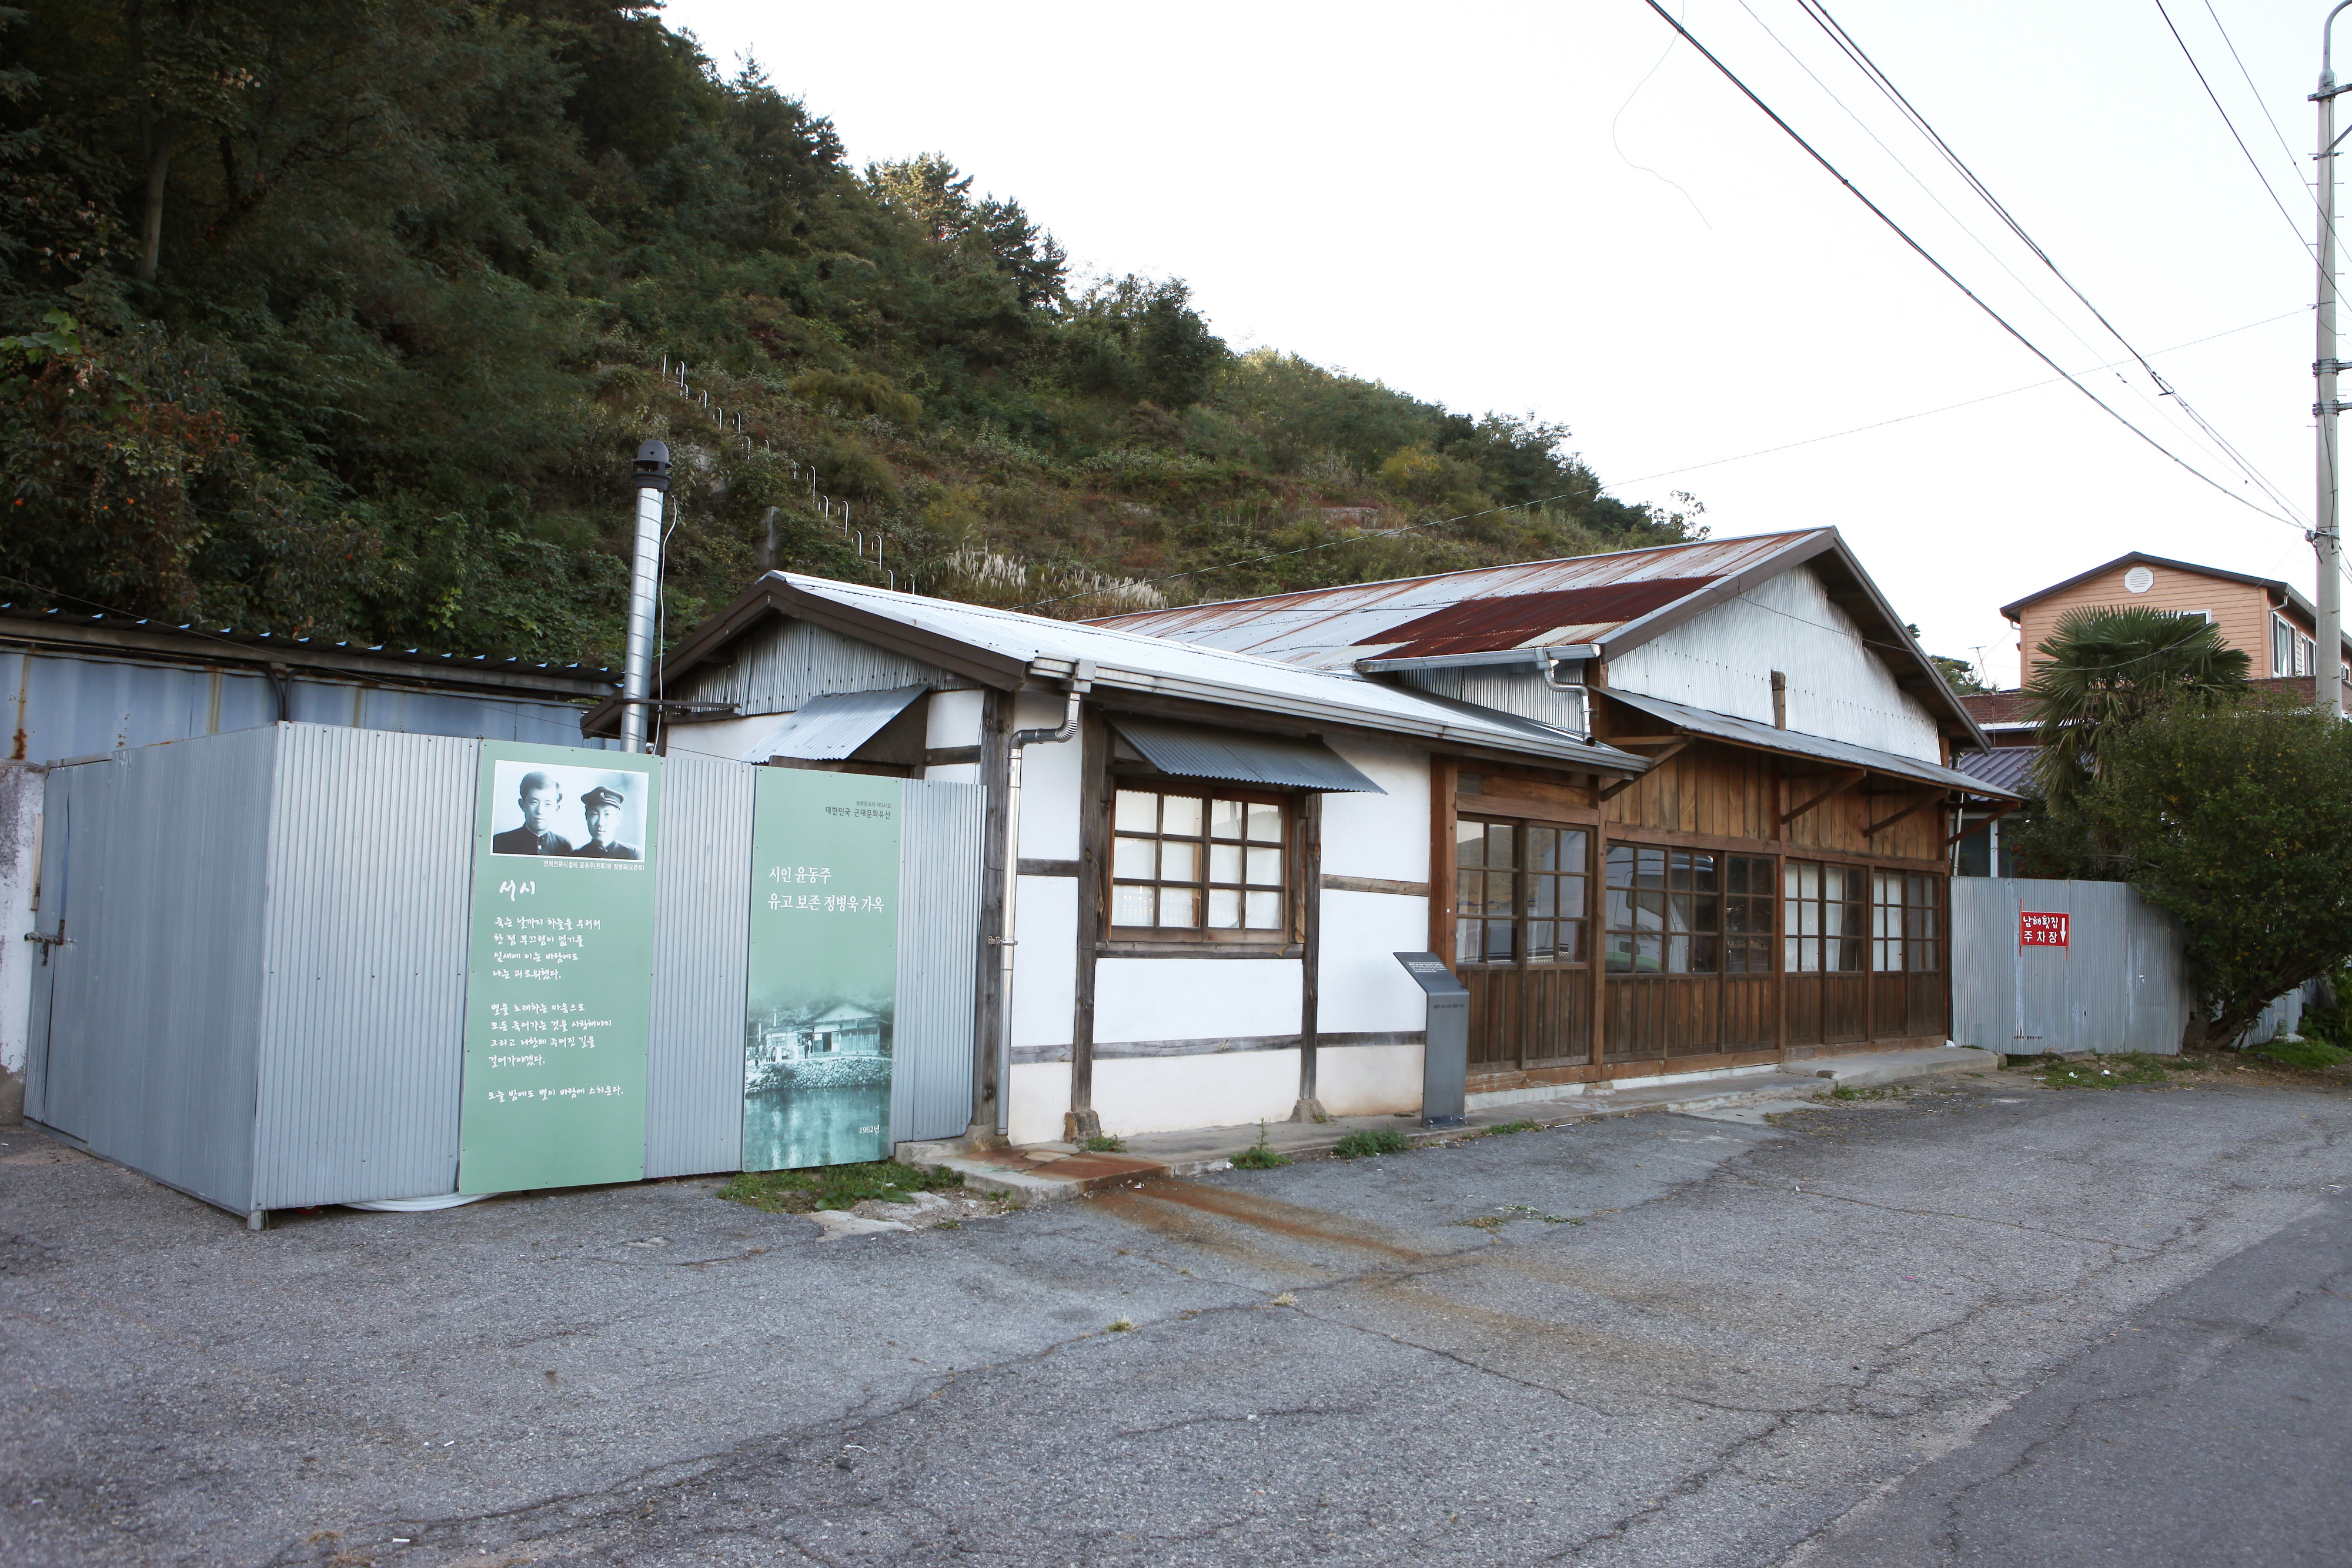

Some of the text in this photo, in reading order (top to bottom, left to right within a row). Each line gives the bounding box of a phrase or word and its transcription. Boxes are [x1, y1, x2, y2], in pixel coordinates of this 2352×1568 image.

[825, 806, 891, 820] 대한민국 근대문화유산
[543, 860, 644, 871] 연희전문시절의 윤동주(왼쪽)와 정병욱(오른쪽)
[769, 866, 832, 885] 시인 윤동주
[767, 892, 884, 913] 유고 보존 정병욱 가옥
[495, 916, 601, 931] 죽는 날까지 하늘을 우러러
[2023, 915, 2059, 929] 남해횟집
[493, 932, 584, 948] 한 점 부끄럼이 없기를
[524, 952, 542, 962] 이는
[545, 952, 579, 964] 바람에도
[492, 968, 562, 981] 나는 괴로워했다.
[490, 1002, 586, 1017] 별을 노래하는 마음으로
[491, 1019, 612, 1032] 모든 죽어가는 것을 사랑해야지
[490, 1035, 596, 1048] 그리고 나한테 주어진 길을
[488, 1054, 546, 1068] 걸어가야겠다.
[488, 1084, 624, 1103] 오늘 밤에도 별이 바람에 스치운다.
[860, 1124, 880, 1134] 1962년
